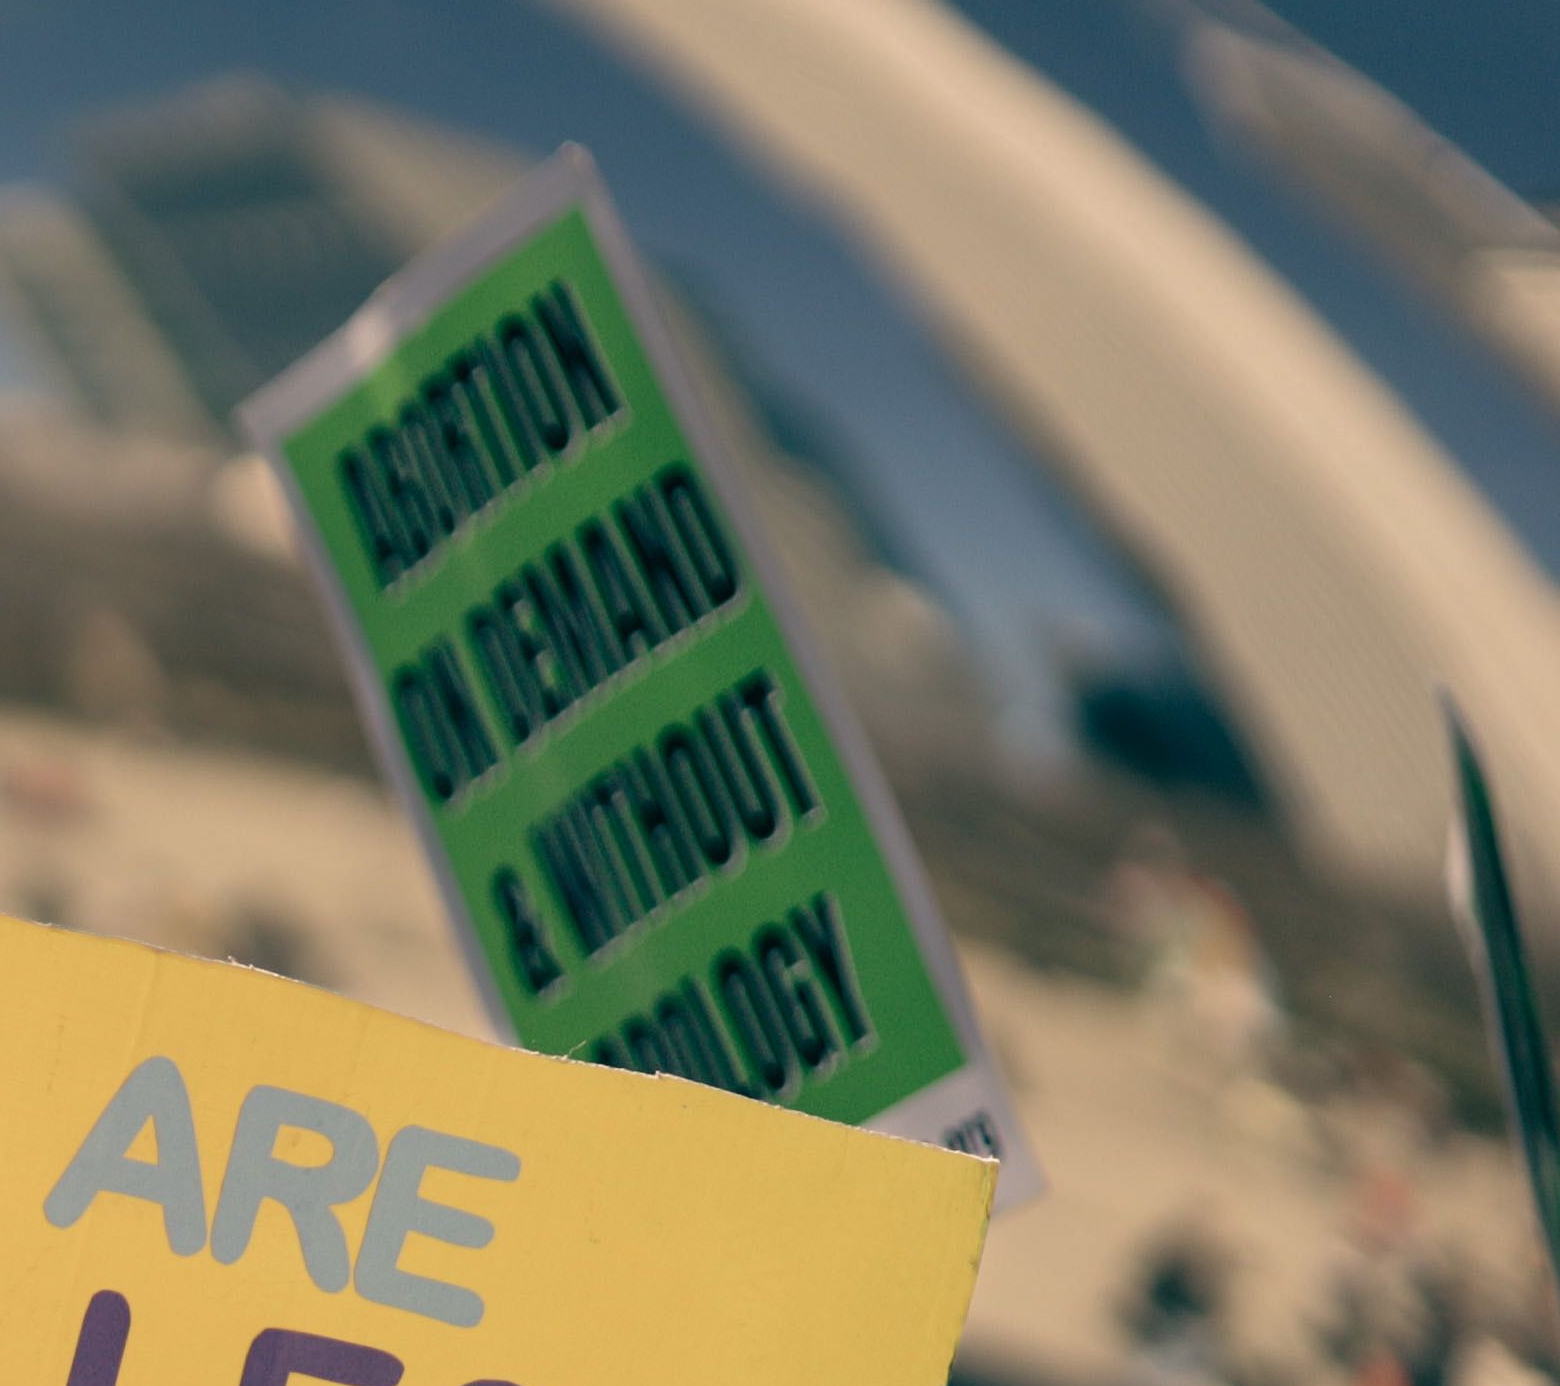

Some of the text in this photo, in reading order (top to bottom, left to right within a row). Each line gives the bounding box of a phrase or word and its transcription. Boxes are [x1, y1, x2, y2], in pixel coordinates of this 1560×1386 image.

[336, 275, 626, 593] ABORTION
[389, 459, 742, 801] ON DEMAND
[492, 667, 825, 997] & WITHOUT
[42, 1054, 523, 1329] ARE
